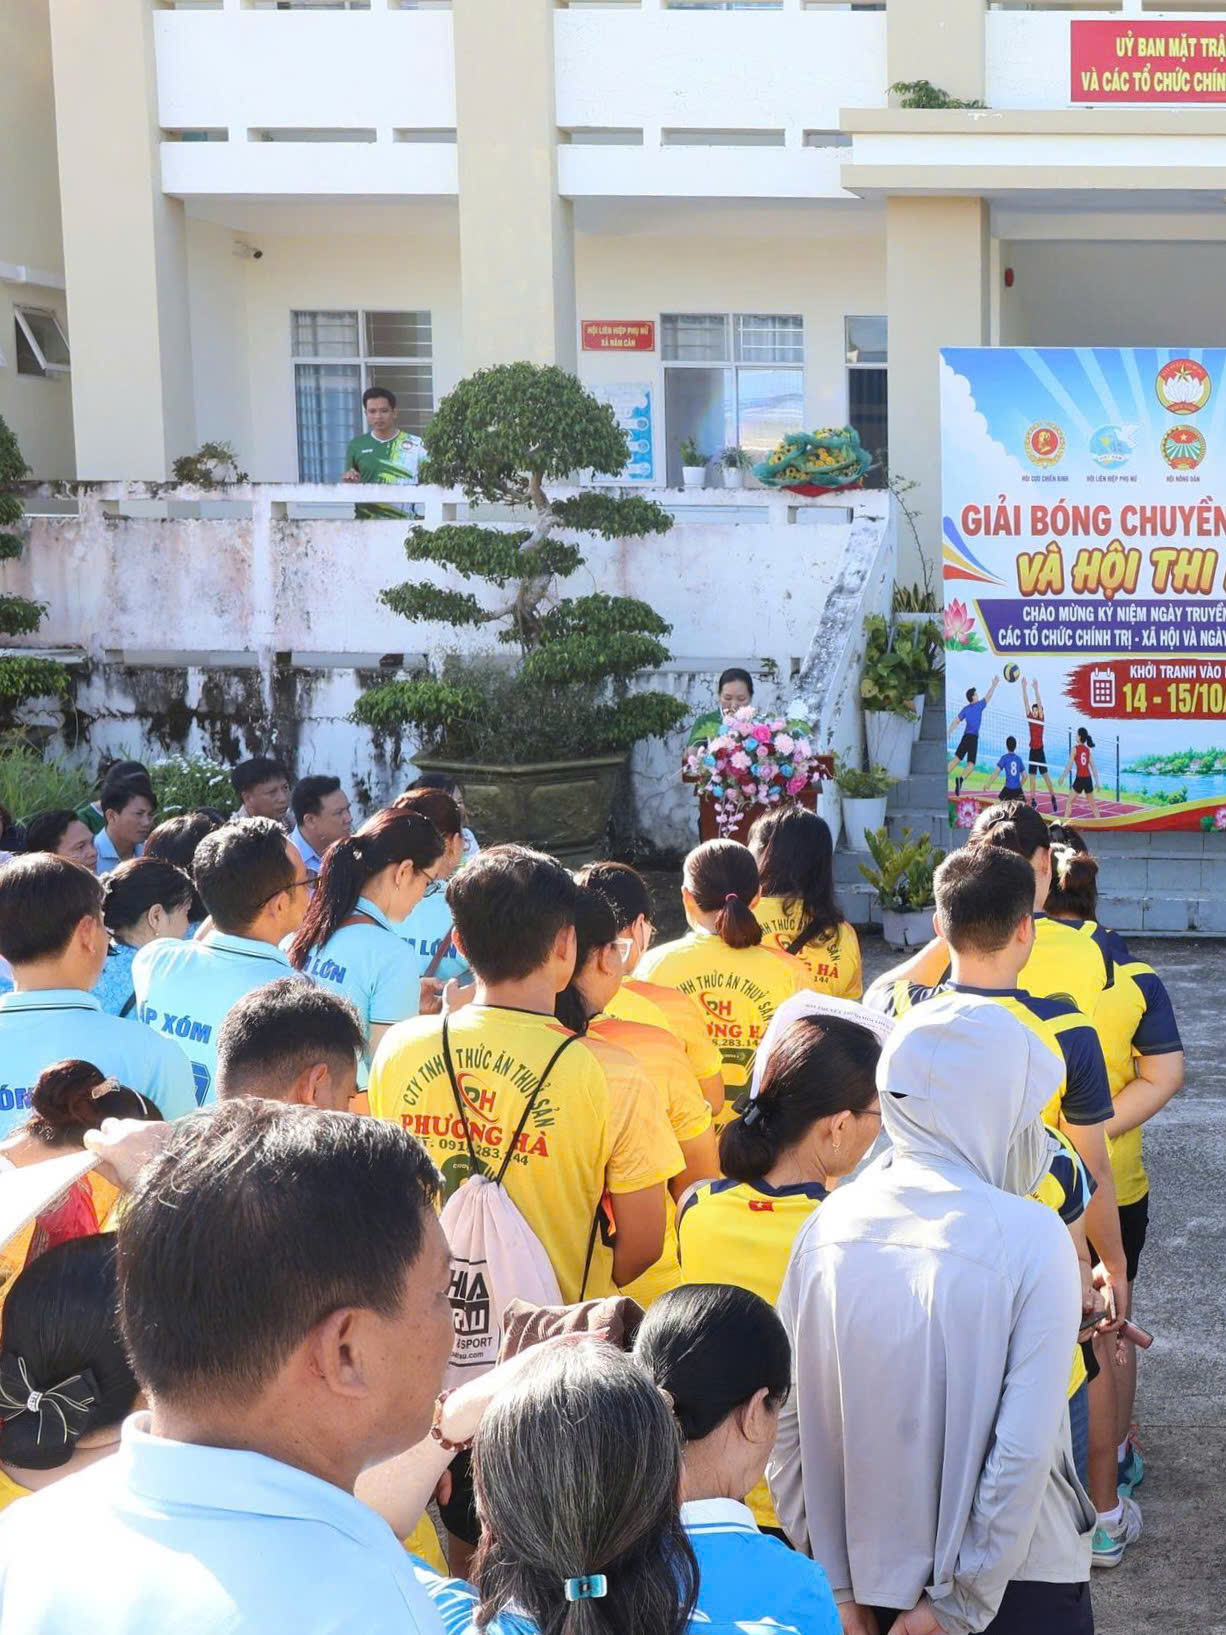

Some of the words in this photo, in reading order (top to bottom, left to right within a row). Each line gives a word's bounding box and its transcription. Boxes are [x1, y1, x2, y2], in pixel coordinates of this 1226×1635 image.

[1116, 30, 1135, 58] UỶ
[1138, 37, 1165, 58] BAN
[1169, 33, 1197, 62] MẶT
[1081, 66, 1099, 91] VÀ
[1102, 66, 1130, 91] CÁC
[1133, 63, 1151, 91] TỔ
[1154, 67, 1191, 92] CHỨC
[961, 494, 1021, 536] GIẢI
[1030, 498, 1112, 536] BÓNG
[1071, 538, 1142, 602] HỘI
[1149, 547, 1218, 596] THI
[1023, 603, 1055, 622] CHÀO
[1059, 603, 1095, 622] MỪNG
[1098, 602, 1113, 622] KỶ
[1117, 604, 1147, 625] NIỆM
[1150, 603, 1183, 622] NGÀY
[998, 625, 1021, 646] CÁC
[1024, 623, 1039, 646] TỔ
[1041, 626, 1073, 646] CHỨC
[1075, 626, 1110, 646] CHÍNH
[1114, 629, 1132, 650] TRỊ
[1142, 626, 1157, 646] XÃ
[1160, 626, 1179, 650] HỘI
[1183, 626, 1197, 646] VÀ
[1130, 661, 1157, 679] KHỞI
[1160, 665, 1196, 679] TRANH
[1200, 663, 1222, 679] VÀO
[1122, 682, 1148, 713] 14
[161, 1013, 212, 1044] XÓM
[403, 1076, 423, 1106] CTY
